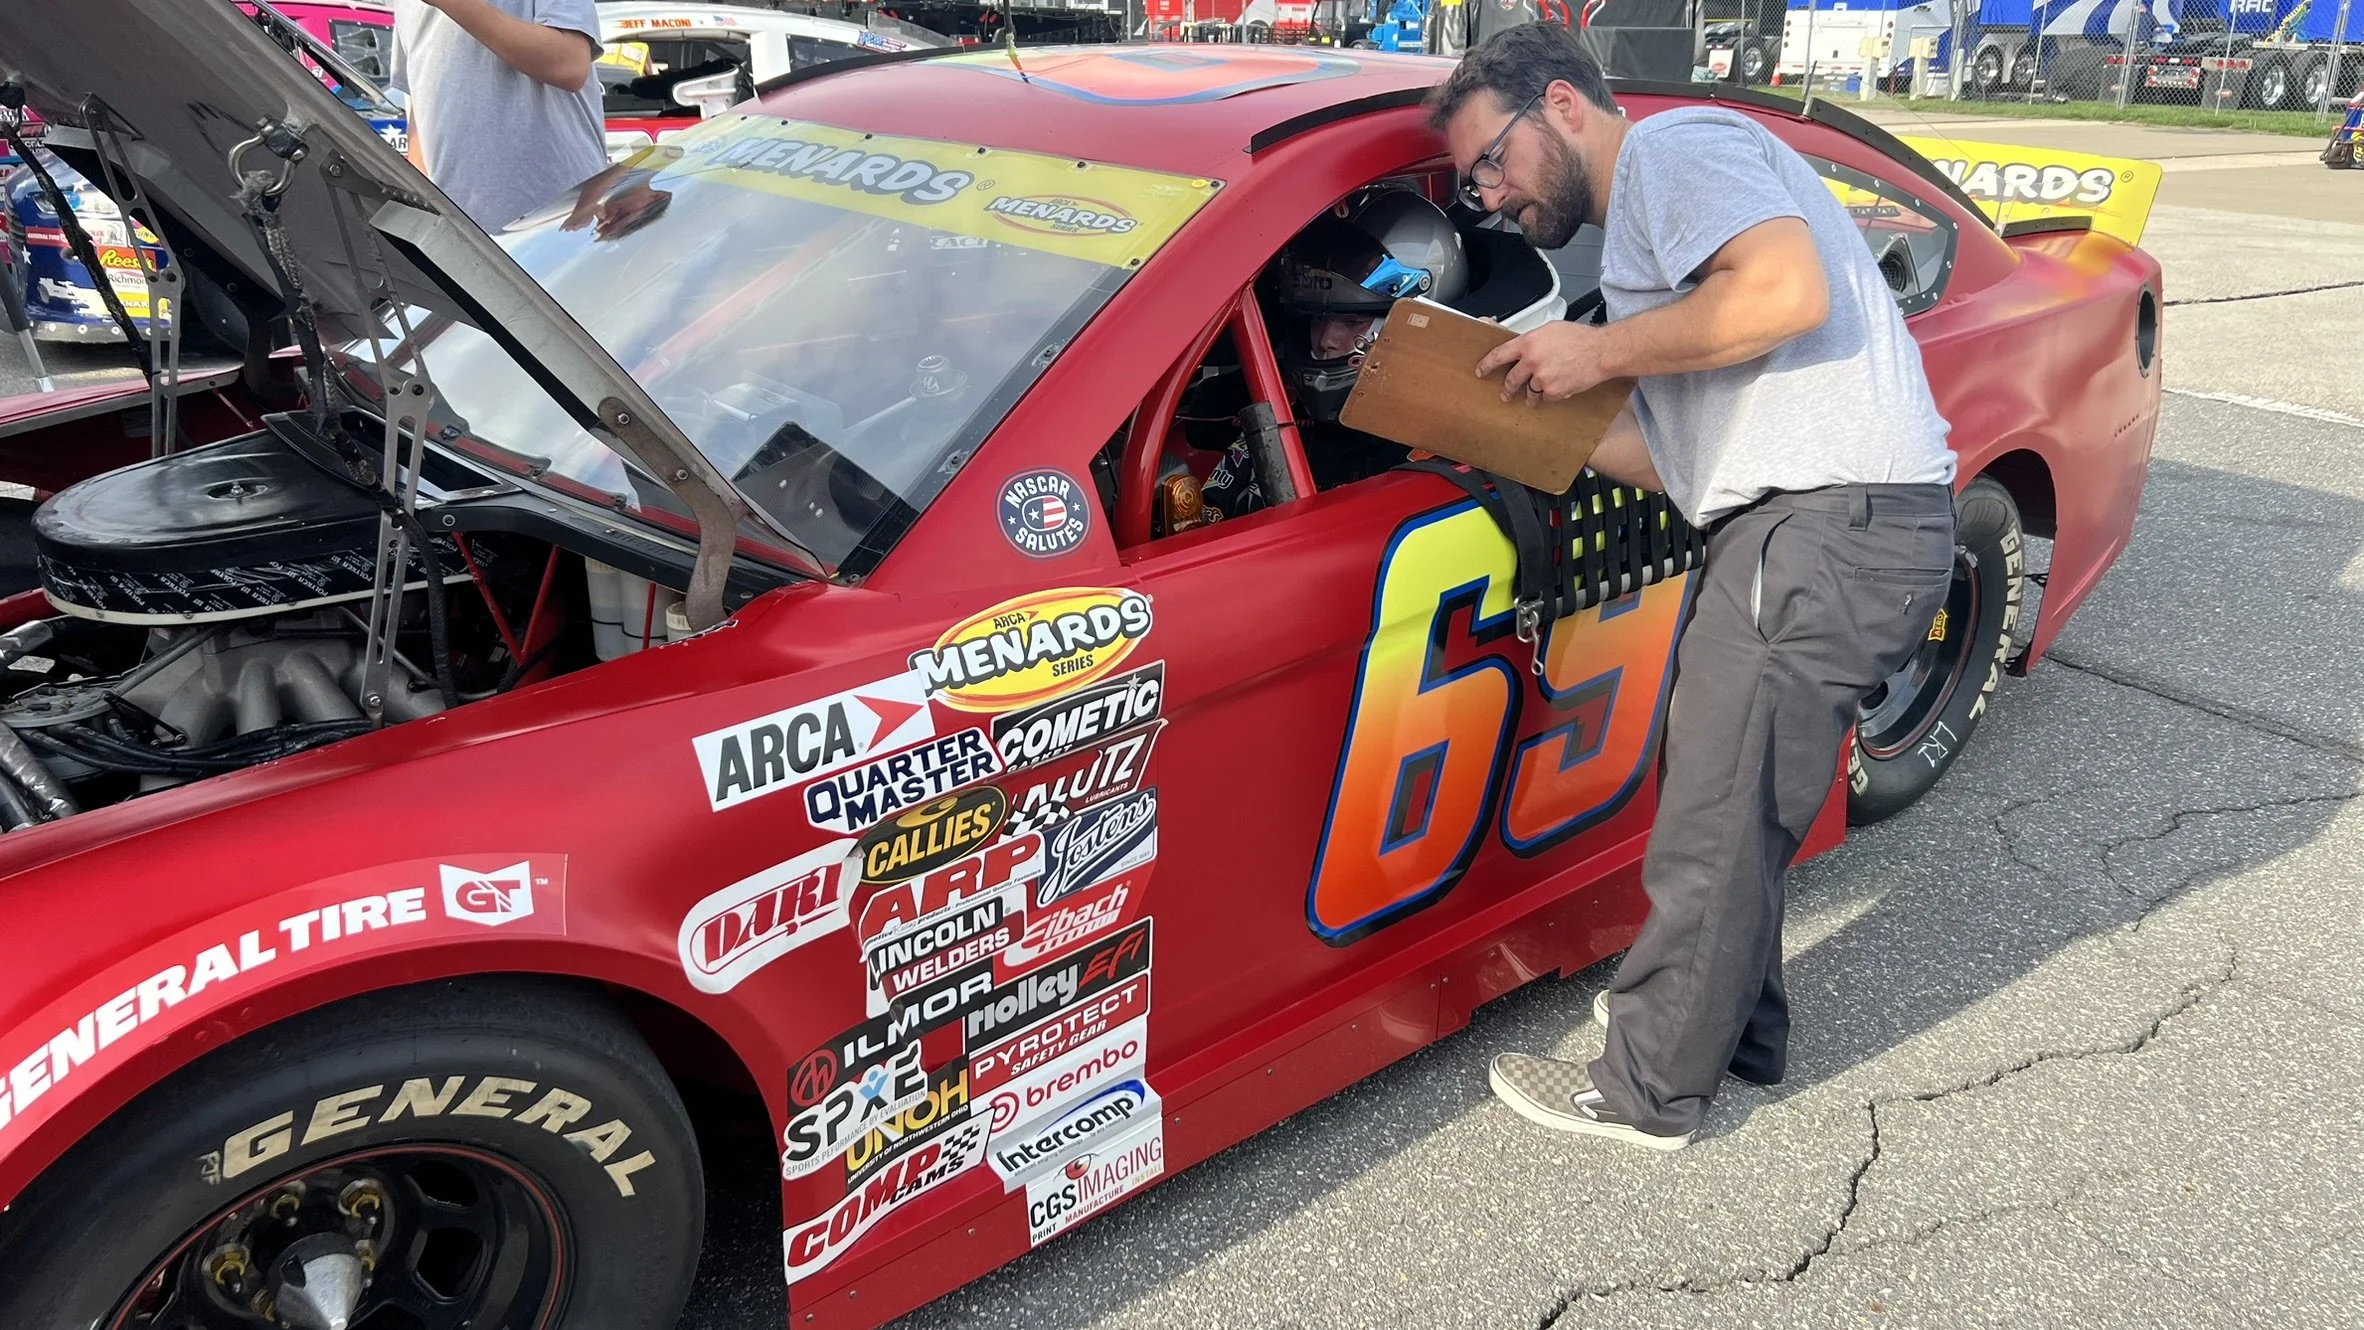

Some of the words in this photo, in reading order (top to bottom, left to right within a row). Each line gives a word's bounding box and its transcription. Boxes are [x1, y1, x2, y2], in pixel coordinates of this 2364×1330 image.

[621, 19, 645, 29] JEFF
[651, 18, 691, 28] MACONI
[705, 137, 974, 205] MENARDS
[1935, 158, 2115, 204] NARDS
[985, 197, 1138, 234] MENARDS
[1050, 224, 1080, 233] SERIES
[1004, 475, 1071, 509] NASCAR
[1014, 517, 1084, 552] SALUTES
[911, 597, 1150, 691] MENARDS
[993, 612, 1026, 630] ARCA
[1969, 521, 2024, 720] GENERAL
[1052, 655, 1094, 677] SERIES
[715, 701, 856, 802] ARCA
[996, 679, 1159, 766] COMETIC
[1304, 490, 1698, 948] 69
[807, 732, 980, 824] QUARTER
[847, 751, 996, 831] MASTER
[1085, 782, 1129, 803] LUBRICANTS
[866, 803, 992, 877] CALLIES
[1038, 793, 1156, 907] Jostens
[279, 887, 426, 952] TIRE
[455, 879, 522, 913] GT
[703, 862, 843, 969] DART
[861, 834, 1041, 936] ARP
[955, 889, 991, 908] Professional
[992, 880, 1013, 893] Quality
[1012, 884, 1129, 954] Eibach
[892, 927, 1010, 992] WELDERS
[1079, 928, 1146, 988] EFI
[843, 971, 993, 1069] ILMOR
[975, 983, 1138, 1080] PYROTECT
[1010, 1039, 1066, 1076] SAFETY
[1069, 1019, 1108, 1047] GEAR
[1026, 1040, 1138, 1108] brembo
[223, 1075, 657, 1198] GENERAL
[785, 1155, 820, 1177] SPORTS
[869, 1114, 879, 1127] BY
[880, 1090, 926, 1119] EVALUATION
[846, 1067, 968, 1172] UNOH
[847, 1153, 885, 1184] UNIVERSITY
[884, 1144, 894, 1155] OF
[893, 1116, 950, 1147] NORTHWESTERN
[950, 1104, 969, 1118] OHIO
[995, 1096, 1134, 1173] Intercomp
[787, 1143, 942, 1267] COMP
[889, 1153, 966, 1206] CAMS
[1032, 1223, 1057, 1243] PRINT
[1064, 1184, 1125, 1225] MANUFACTURE
[1131, 1163, 1162, 1186] INSTALL
